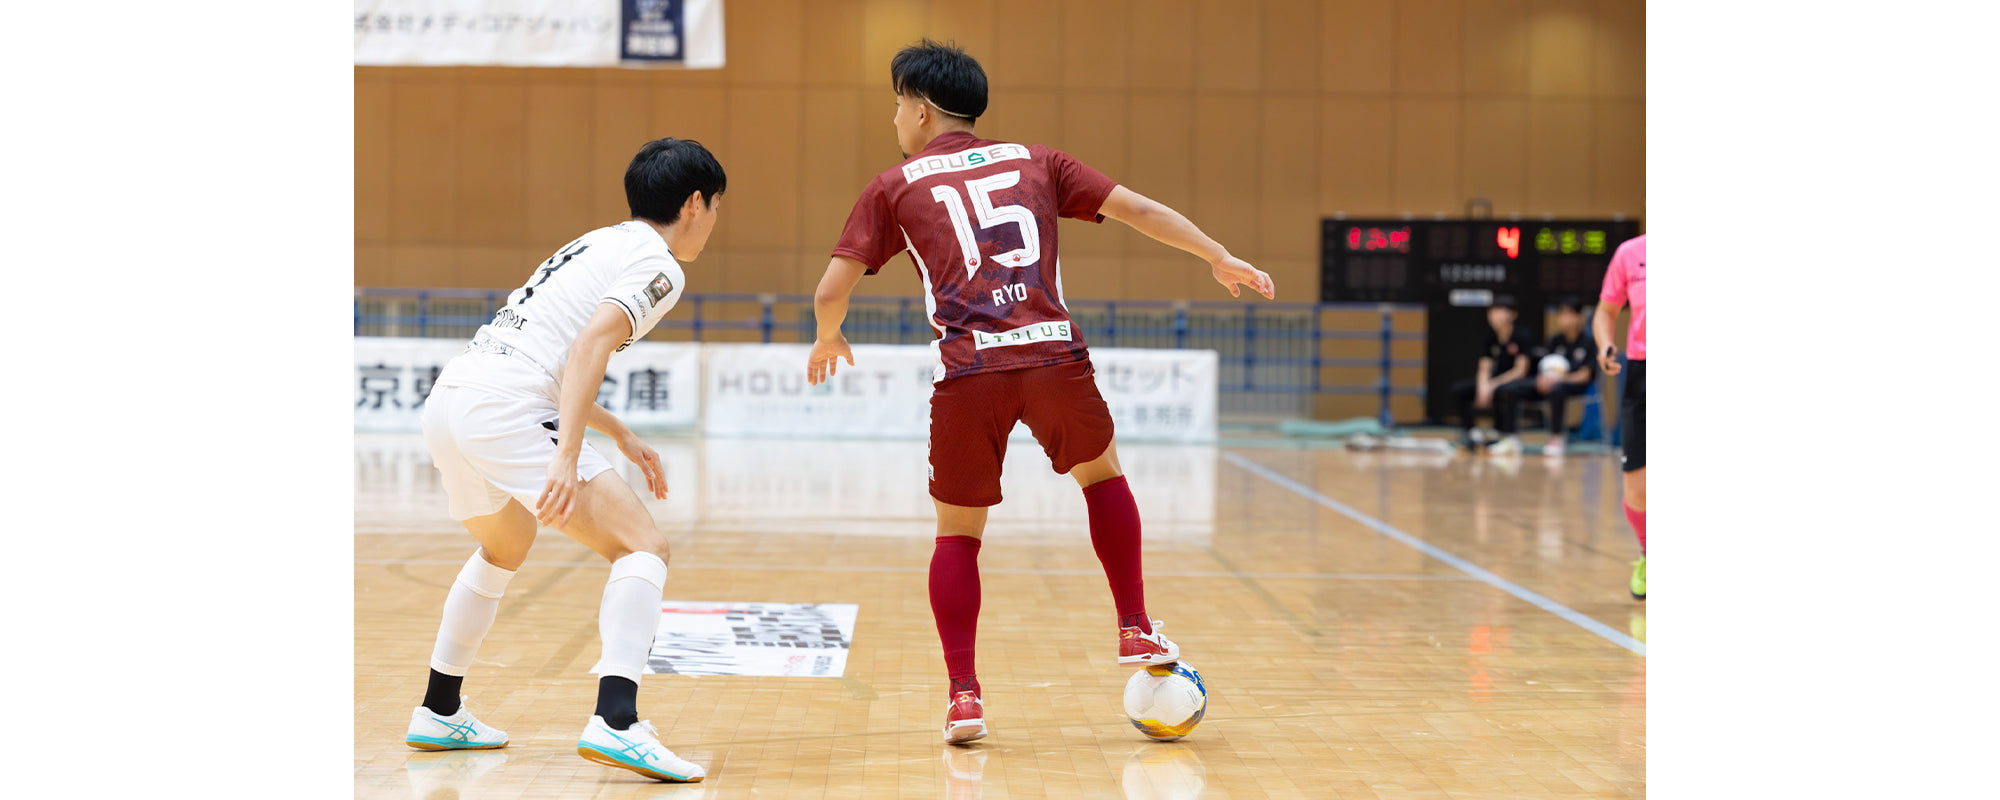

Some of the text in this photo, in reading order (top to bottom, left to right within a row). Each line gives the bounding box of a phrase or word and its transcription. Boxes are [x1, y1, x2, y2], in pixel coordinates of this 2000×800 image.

[906, 146, 1023, 178] HOUSET
[930, 170, 1040, 281] 15
[1497, 227, 1520, 259] 4
[992, 283, 1027, 306] RYO
